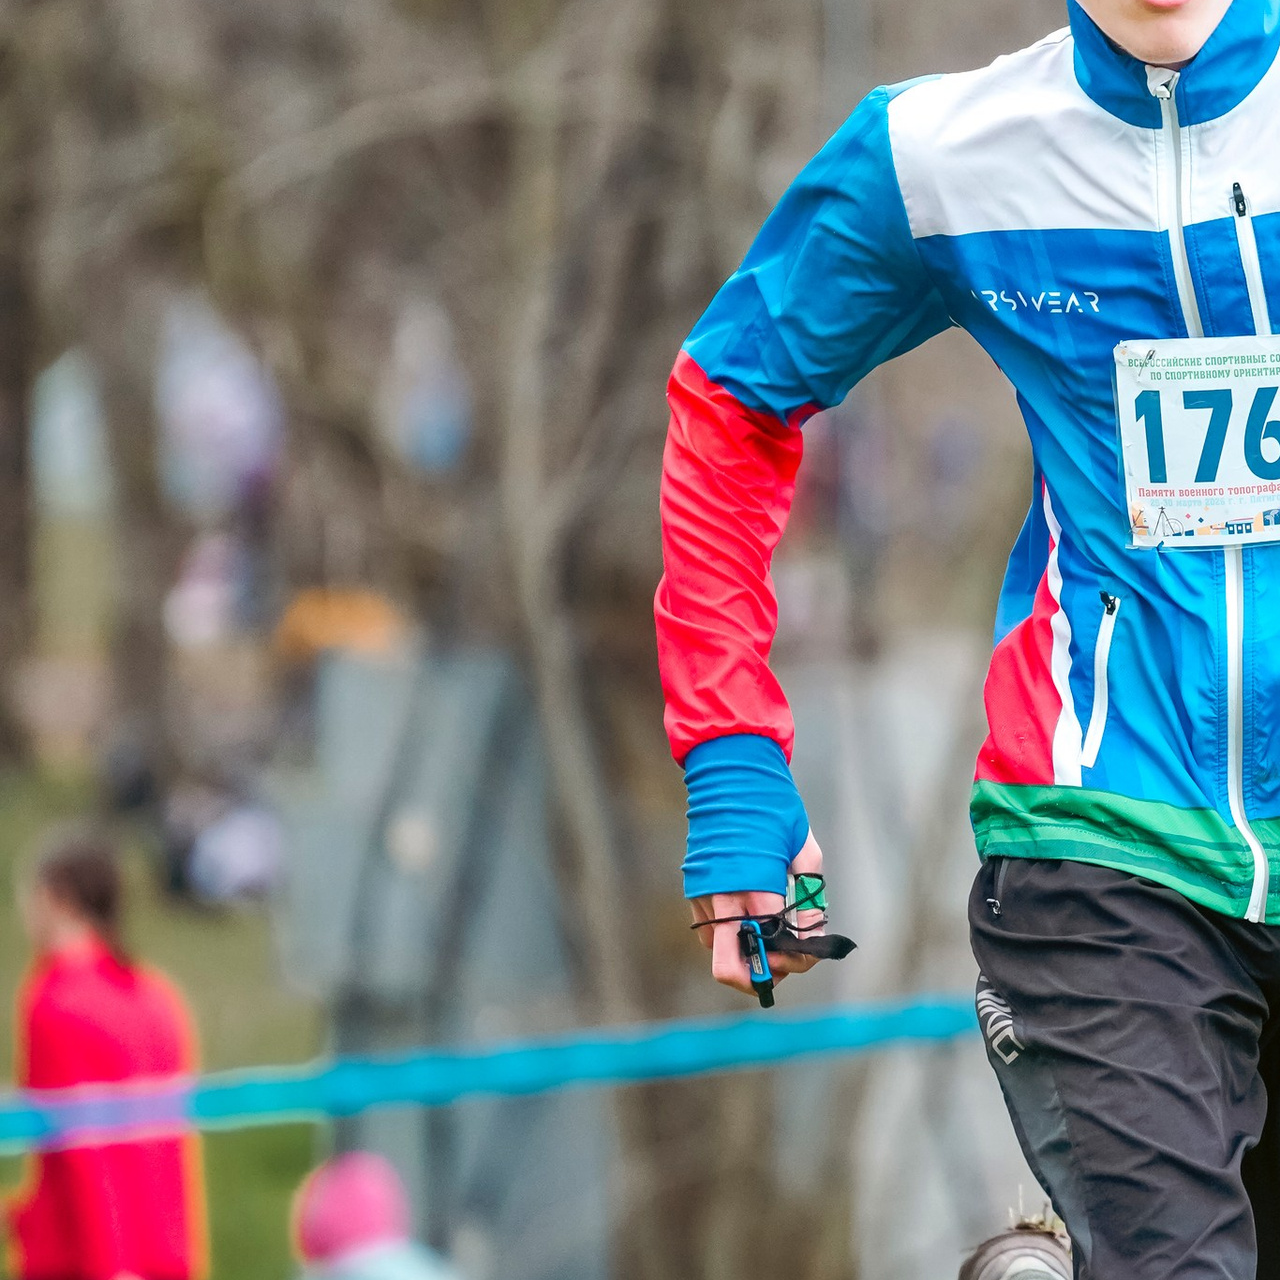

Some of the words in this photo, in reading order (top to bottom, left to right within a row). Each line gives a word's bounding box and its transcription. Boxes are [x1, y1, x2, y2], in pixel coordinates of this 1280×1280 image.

[1205, 354, 1267, 366] СПОРТИВНЫЕ
[1150, 371, 1162, 380] ПО
[1165, 369, 1231, 380] СПОРТИВНОМУ
[1138, 487, 1175, 498] Памяти
[1179, 488, 1224, 498] военного
